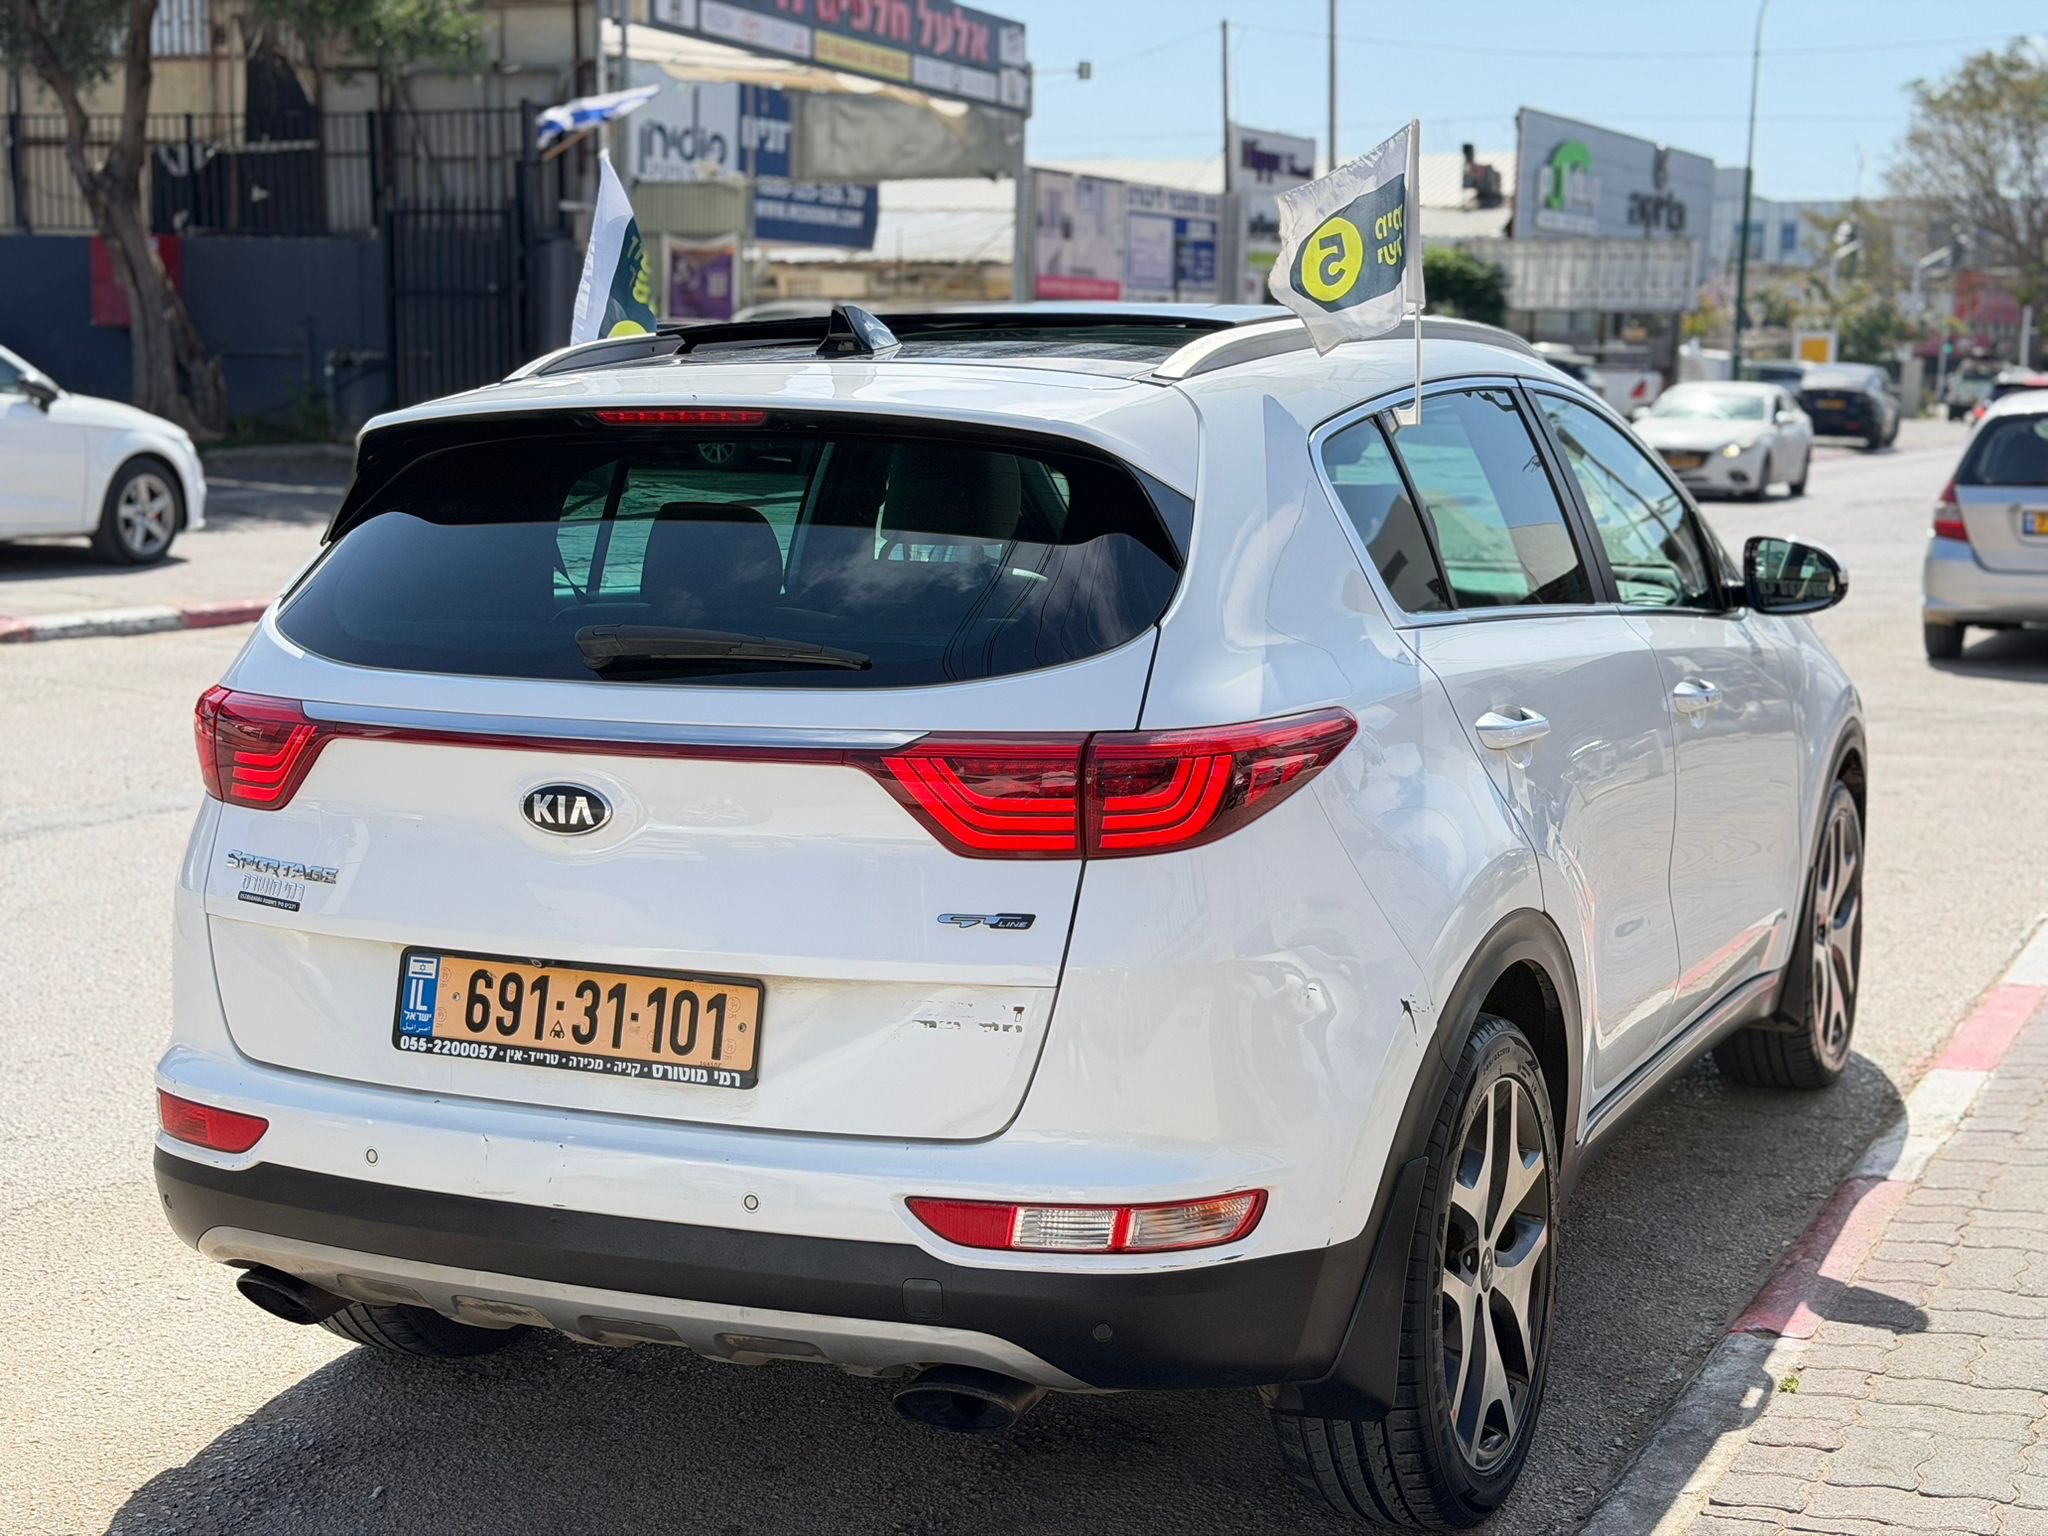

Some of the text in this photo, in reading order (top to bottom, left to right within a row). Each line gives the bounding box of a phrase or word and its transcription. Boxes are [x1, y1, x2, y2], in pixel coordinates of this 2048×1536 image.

[533, 793, 595, 825] KIA
[226, 849, 339, 884] SPORTAGE
[998, 920, 1028, 929] LINE
[408, 978, 428, 1011] IL
[403, 1009, 432, 1022] ישראל
[400, 1035, 498, 1060] 055-2200057
[505, 1048, 559, 1066] טרייד-אין
[568, 1055, 604, 1071] מכירה
[613, 1061, 641, 1076] קניה
[652, 1064, 709, 1083] מוטורס
[713, 1070, 741, 1087] רמי
